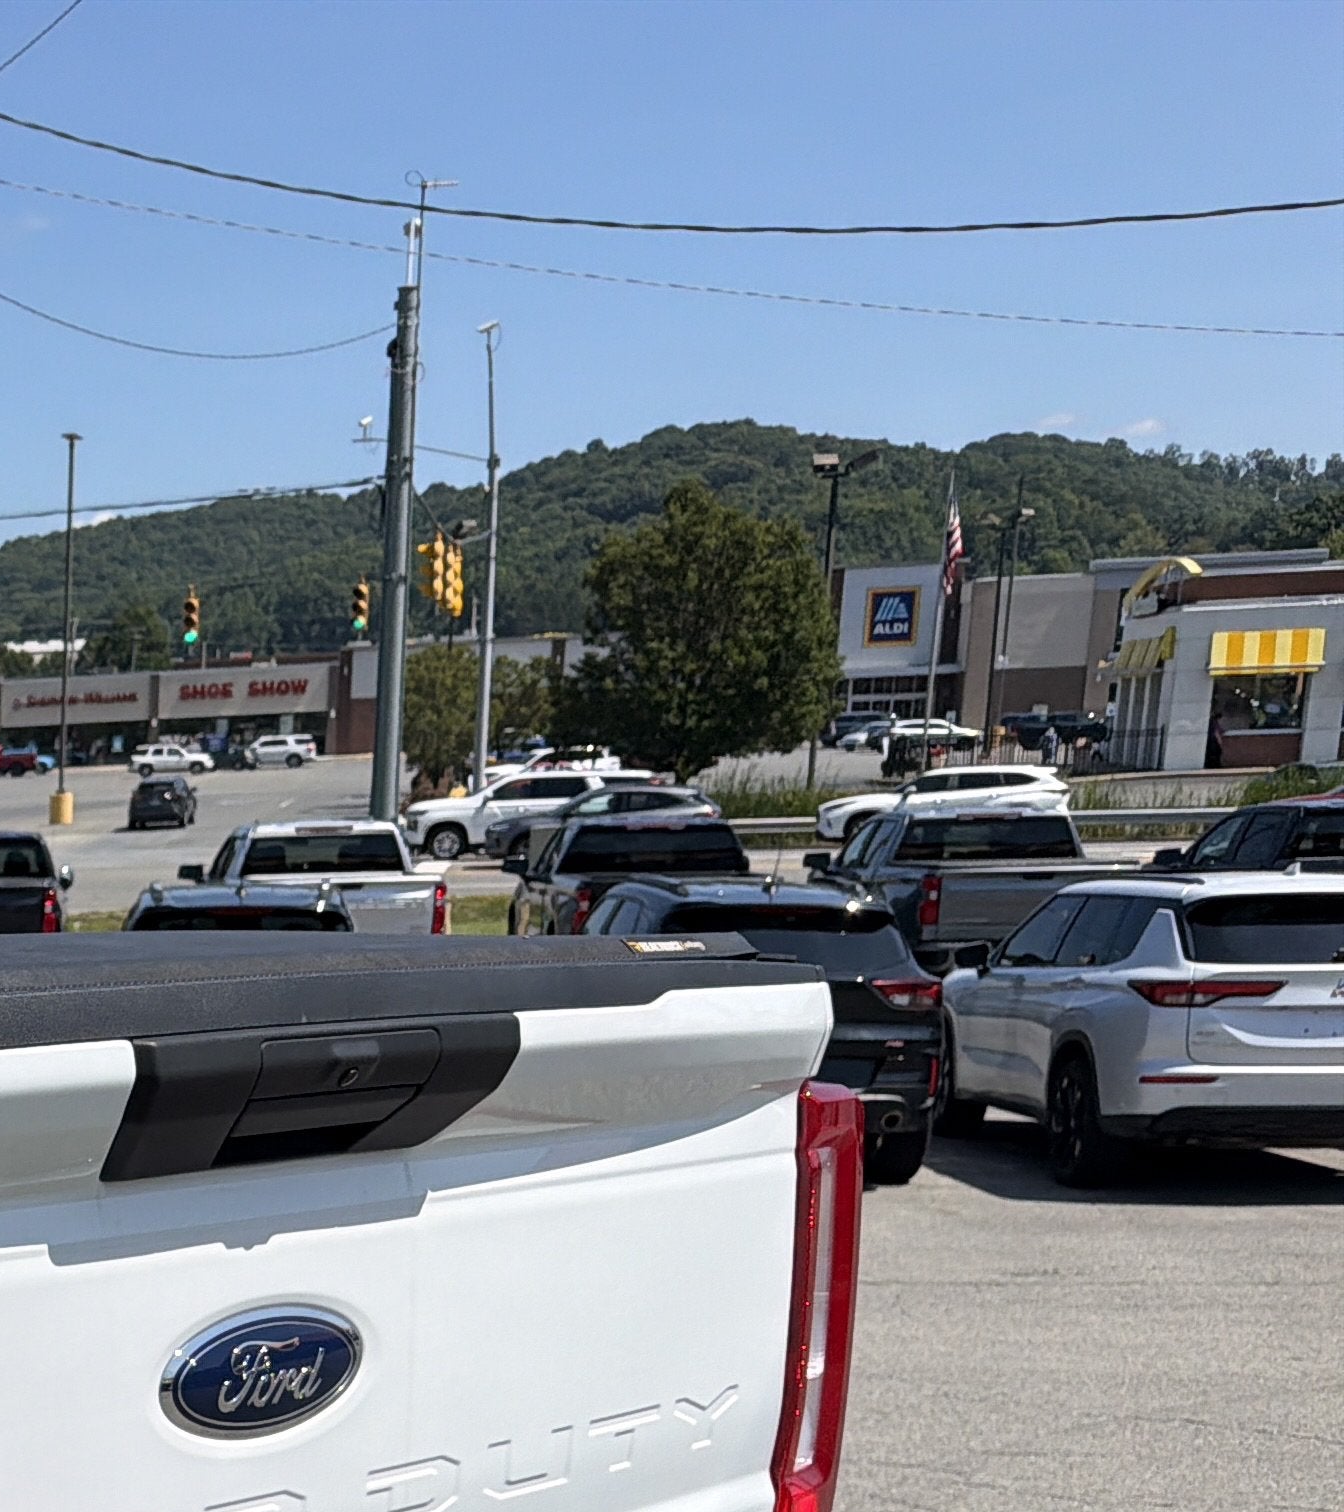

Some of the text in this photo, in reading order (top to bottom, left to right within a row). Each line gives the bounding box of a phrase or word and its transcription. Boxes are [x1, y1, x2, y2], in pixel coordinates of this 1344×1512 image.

[873, 622, 909, 634] ALDI
[180, 678, 309, 700] SHOE SHOW
[218, 1336, 325, 1414] Ford
